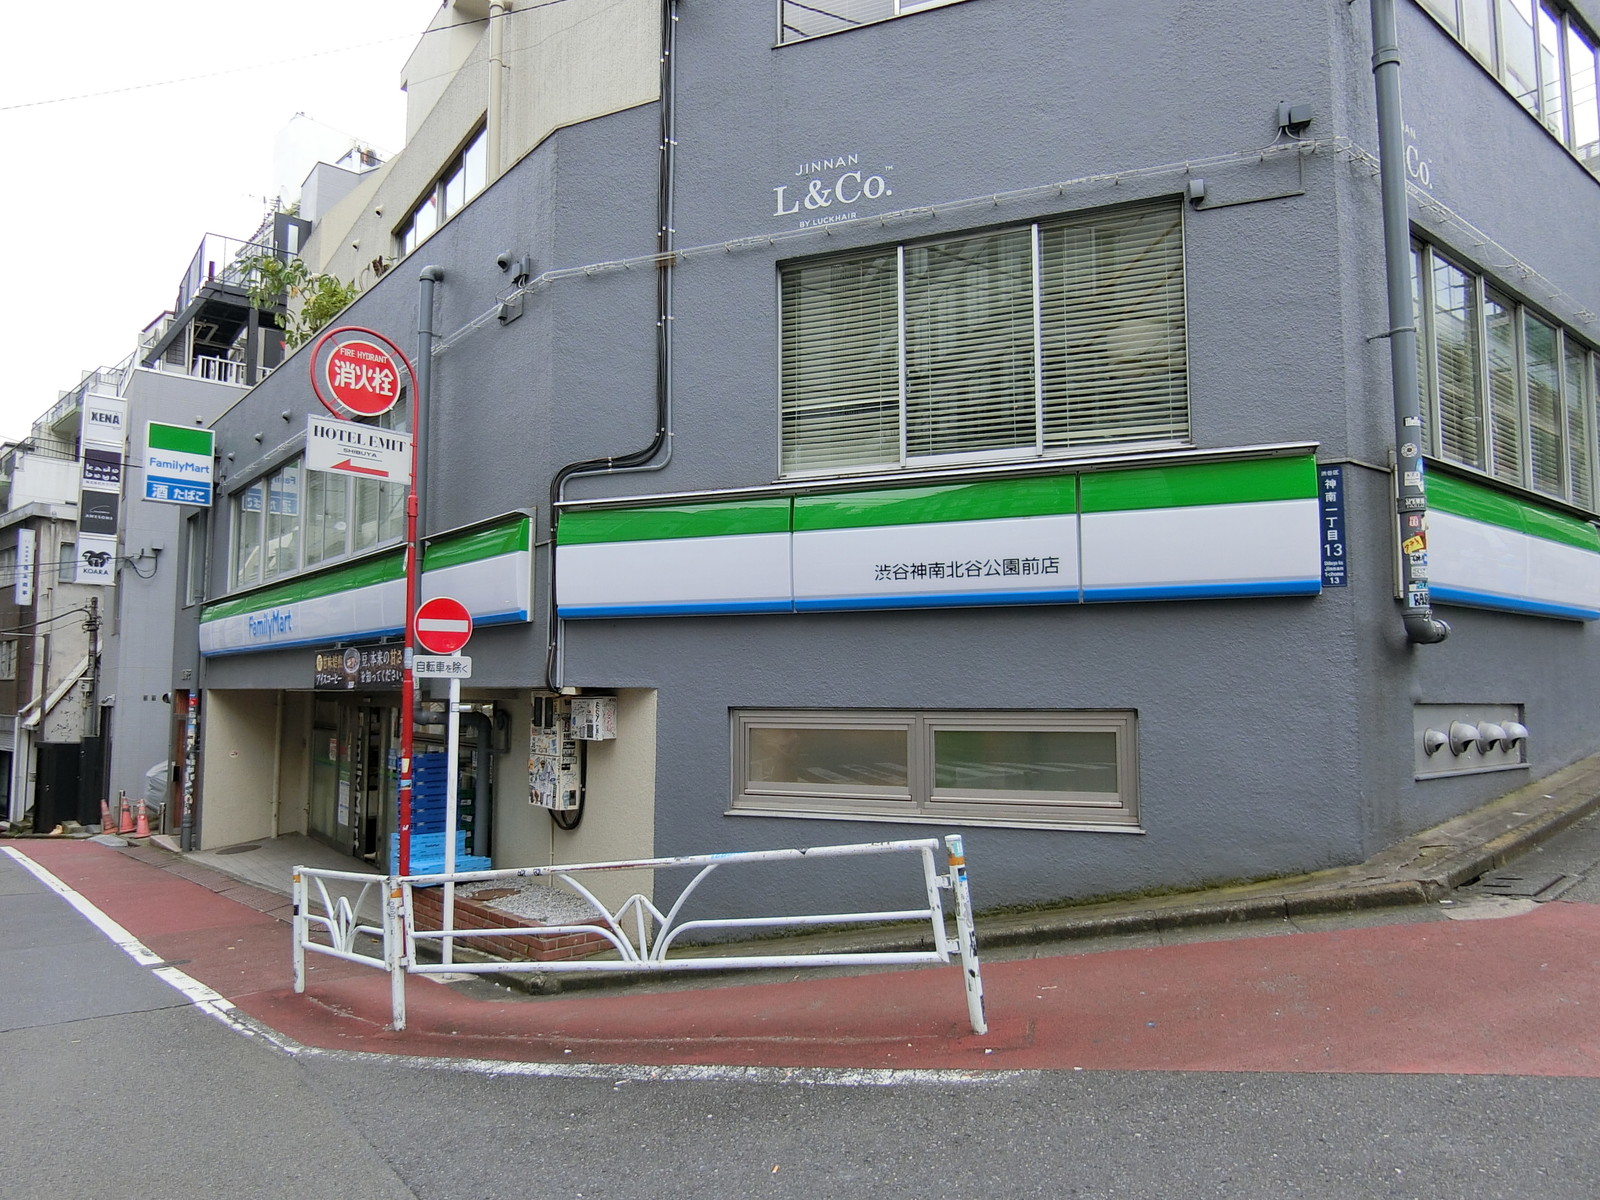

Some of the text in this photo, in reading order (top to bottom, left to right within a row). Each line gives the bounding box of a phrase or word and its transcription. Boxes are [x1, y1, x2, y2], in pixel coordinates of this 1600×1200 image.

[795, 153, 859, 176] JINNAN
[773, 170, 893, 217] L&Co.
[799, 212, 857, 228] BY LUCKHAIR
[340, 348, 388, 364] FIRE HYDRANT
[334, 359, 394, 396] 消火栓
[313, 425, 407, 452] HOTEL EMIT
[343, 447, 378, 458] SHIBUYA
[149, 457, 210, 475] FamilyMart
[151, 484, 206, 502] 酒 たばこ
[1324, 478, 1339, 541] 神南一丁目
[1324, 543, 1343, 557] 13
[82, 568, 109, 576] KOARA
[874, 556, 1060, 582] 渋谷神南北谷公園前店
[249, 610, 292, 640] FamilyMart
[416, 660, 468, 674] 自転車を除く
[315, 672, 343, 686] アイスコーヒー
